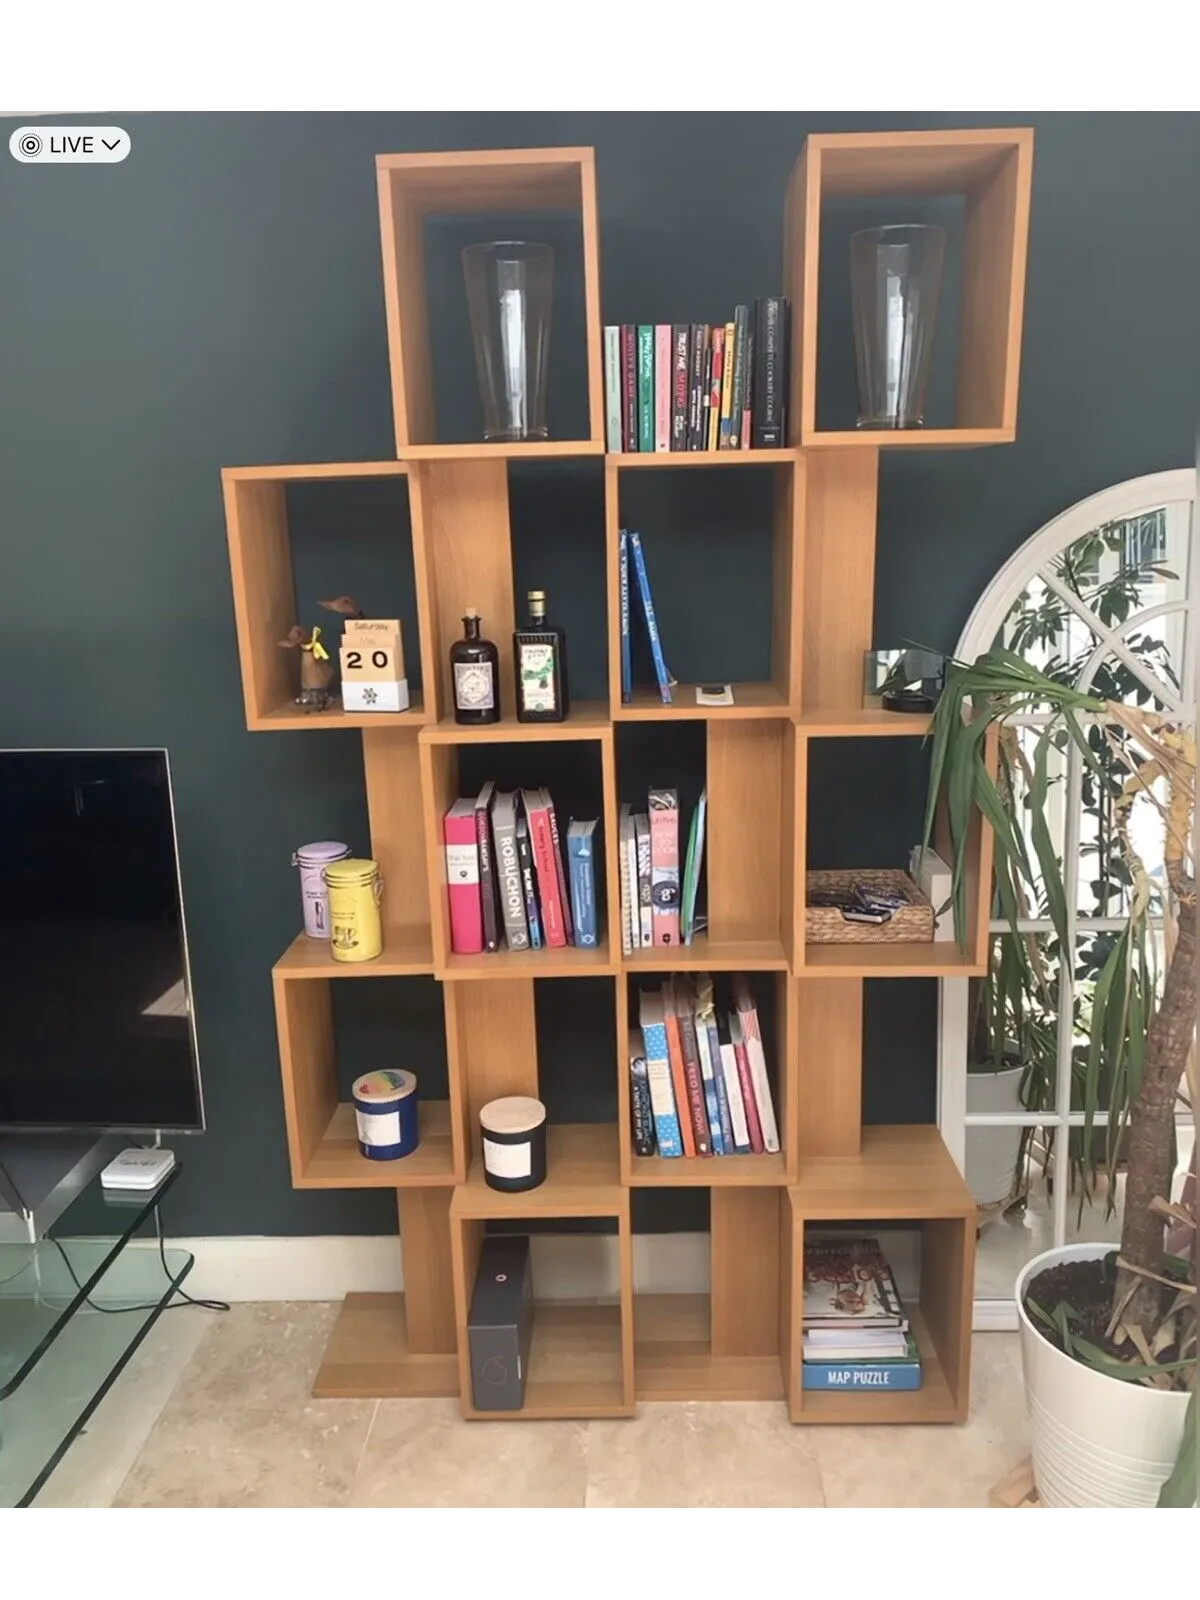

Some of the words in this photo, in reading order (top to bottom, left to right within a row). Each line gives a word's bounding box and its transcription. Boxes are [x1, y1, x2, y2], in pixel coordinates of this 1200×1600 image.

[677, 332, 686, 355] TRUST
[354, 621, 389, 631] Saturday
[550, 813, 559, 845] SAUCES
[501, 836, 522, 918] ROBUCHON
[687, 1061, 700, 1089] FEED
[693, 1108, 705, 1136] NOW!
[828, 1371, 851, 1385] MAP
[853, 1371, 890, 1385] PUZZLE
